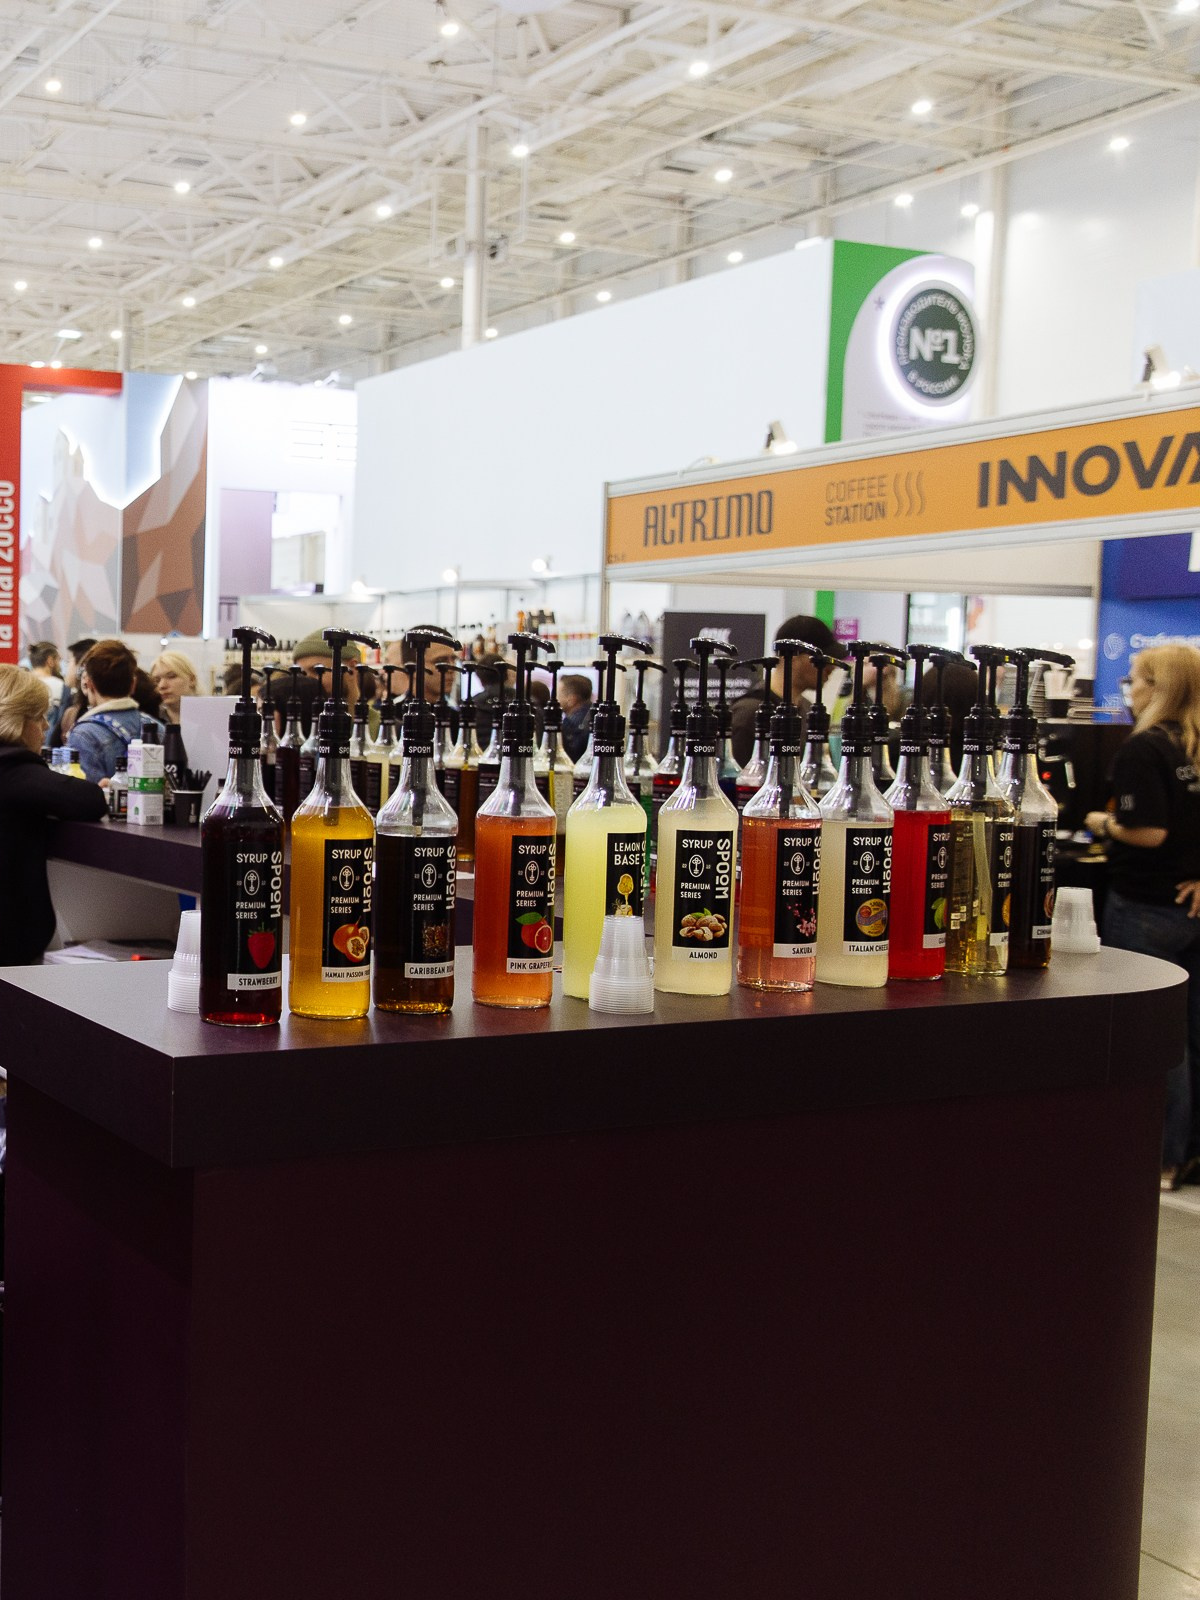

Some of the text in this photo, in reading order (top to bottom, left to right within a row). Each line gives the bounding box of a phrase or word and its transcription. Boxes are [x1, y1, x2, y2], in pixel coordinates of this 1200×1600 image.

[825, 475, 887, 503] COFFEE
[644, 490, 773, 547] ALTRIMO
[824, 501, 886, 527] STATION
[408, 746, 431, 754] SPOOM
[594, 745, 615, 753] SPOOM
[693, 745, 715, 753] SPOOM
[682, 838, 714, 849] SYRUP
[784, 837, 813, 847] SYRUP
[853, 836, 882, 846] SYRUP
[518, 844, 547, 855] SYRUP
[614, 842, 641, 852] LEMON
[331, 849, 362, 859] SYRUP
[414, 847, 445, 858] SYRUP
[236, 853, 268, 864] SYRUP
[614, 854, 640, 866] BASE
[714, 838, 731, 899] SPOOM
[882, 835, 893, 894] SPOOM
[445, 845, 457, 910] SPOOM
[547, 843, 557, 907] SPOOM
[270, 851, 282, 918] SPOOM
[363, 847, 373, 913] SPOOM
[782, 880, 810, 888] PREMIUM
[852, 878, 880, 886] PREMIUM
[680, 882, 711, 890] PREMIUM
[516, 890, 544, 898] PREMIUM
[680, 891, 702, 899] SERIES
[851, 887, 872, 895] SERIES
[330, 896, 360, 904] PREMIUM
[413, 893, 443, 901] PREMIUM
[235, 901, 266, 909] PREMIUM
[413, 903, 435, 911] SERIES
[516, 899, 537, 907] SERIES
[330, 906, 352, 914] SERIES
[235, 911, 258, 919] SERIES
[791, 947, 813, 955] SAKURA
[848, 945, 874, 953] ITALIAN
[688, 951, 718, 960] ALMOND
[510, 961, 527, 970] PINK
[325, 970, 345, 978] HAWAII
[346, 970, 364, 978] PASSION
[409, 966, 446, 975] CARIBBEAN
